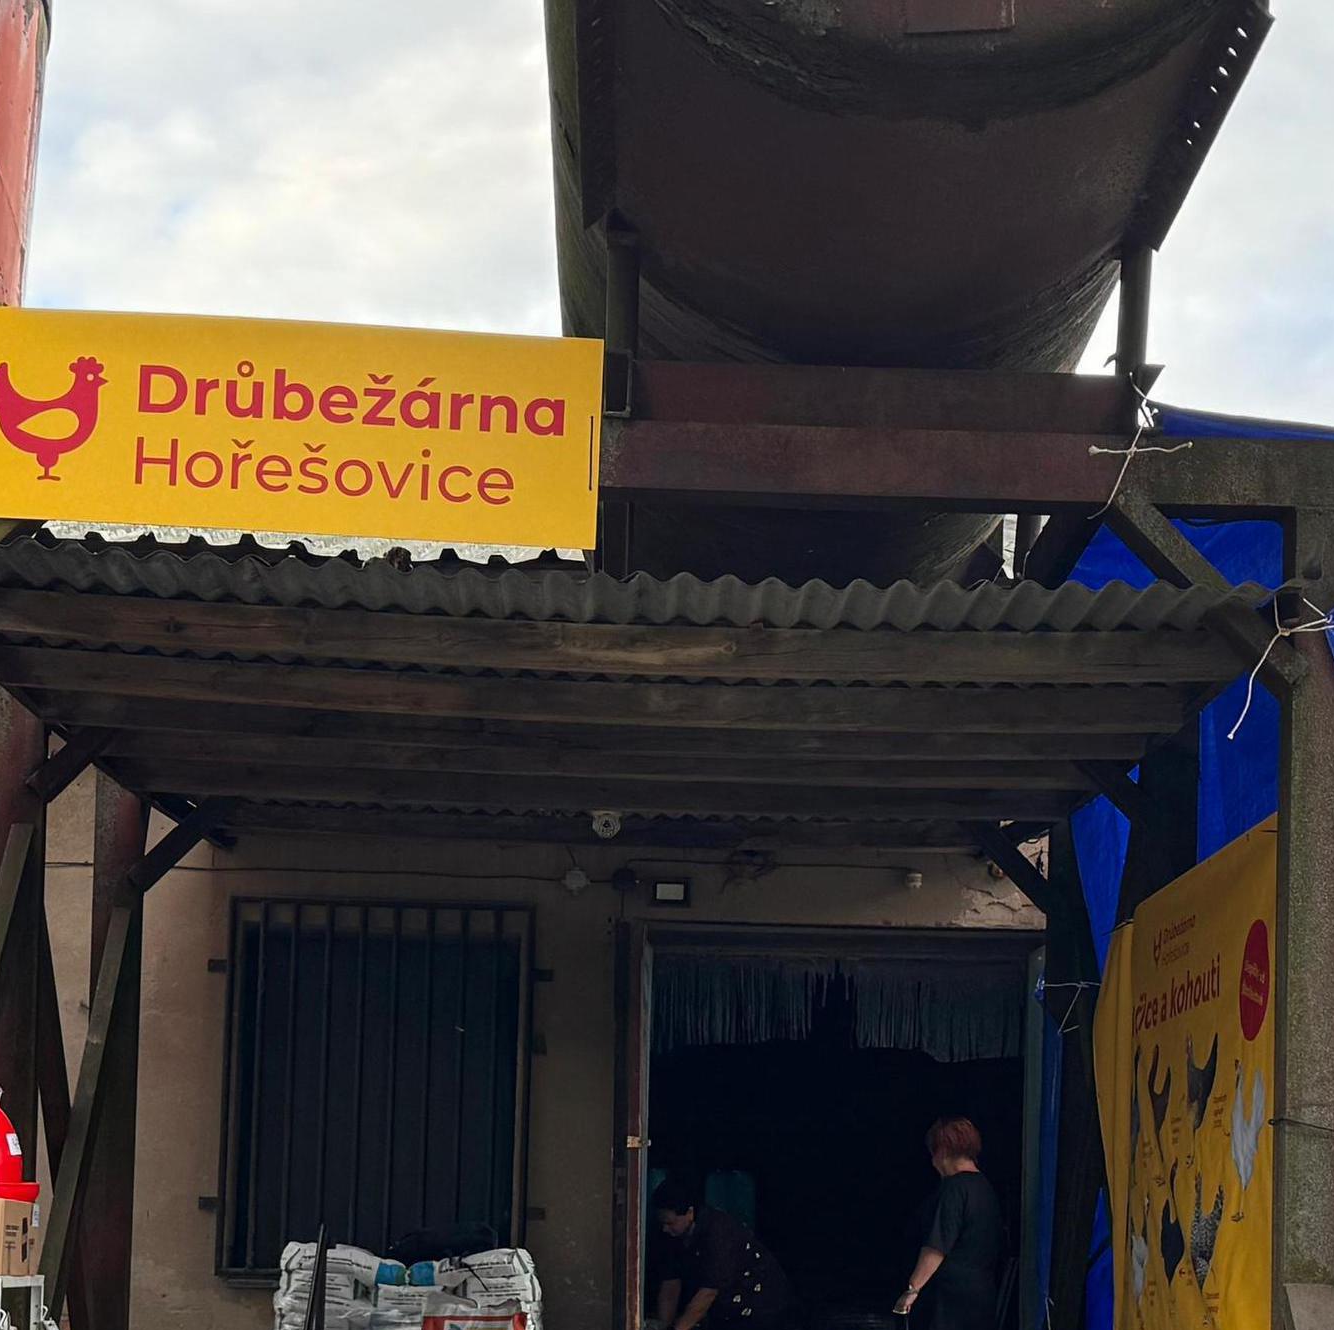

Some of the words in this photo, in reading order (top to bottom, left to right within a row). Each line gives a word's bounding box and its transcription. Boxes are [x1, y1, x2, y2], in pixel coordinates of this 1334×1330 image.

[138, 361, 565, 436] Drůbežárna
[135, 437, 514, 505] Hořešovice
[1170, 954, 1220, 1018] kohouti
